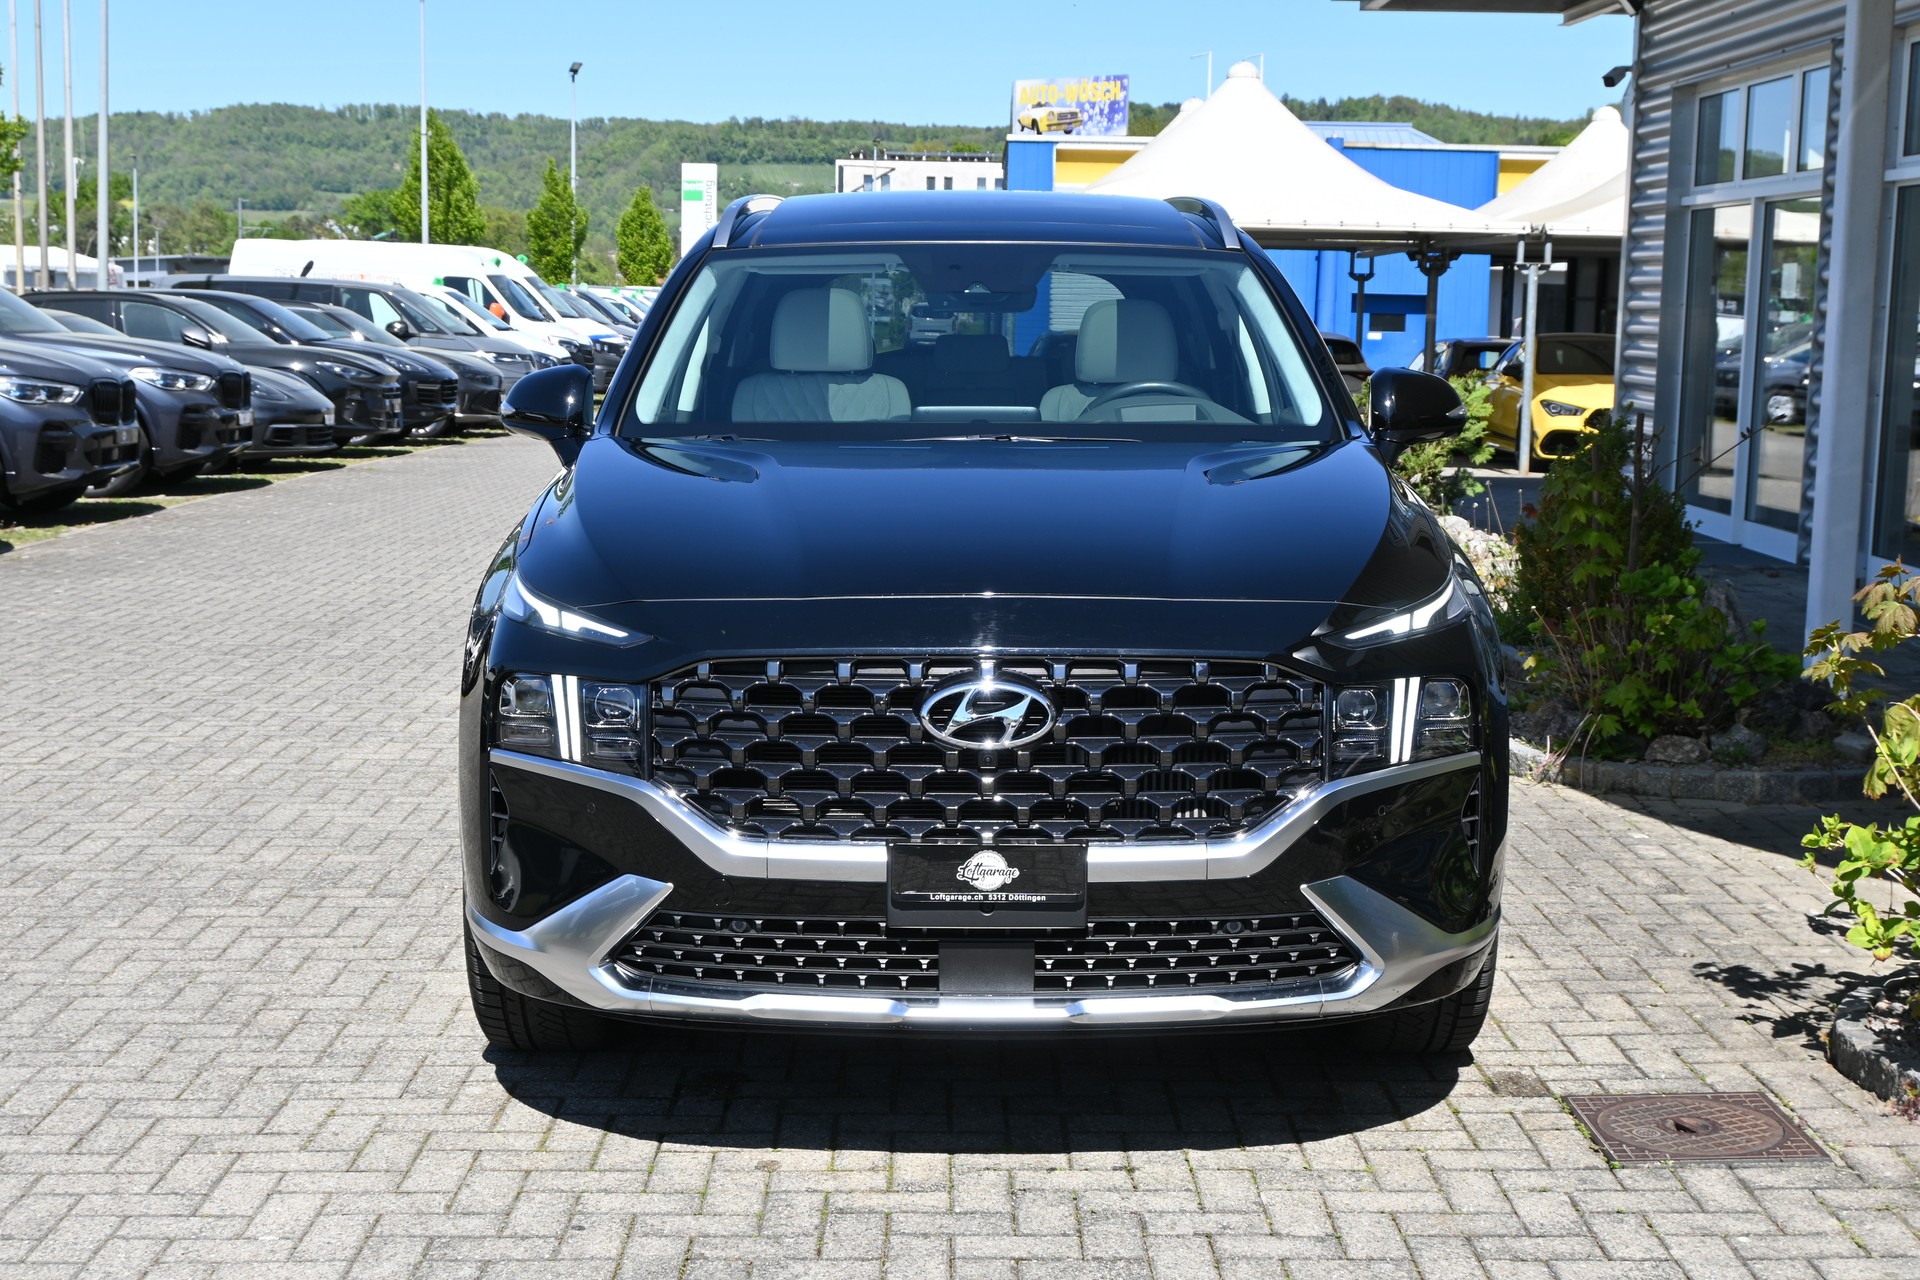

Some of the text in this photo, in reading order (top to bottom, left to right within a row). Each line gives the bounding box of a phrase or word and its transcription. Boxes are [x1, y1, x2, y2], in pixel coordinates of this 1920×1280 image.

[1020, 79, 1122, 105] AUTO-WÖSCH
[958, 860, 1019, 883] Loftgarage
[930, 894, 984, 902] Loftgarage.ch
[1008, 894, 1046, 902] Döttingen
